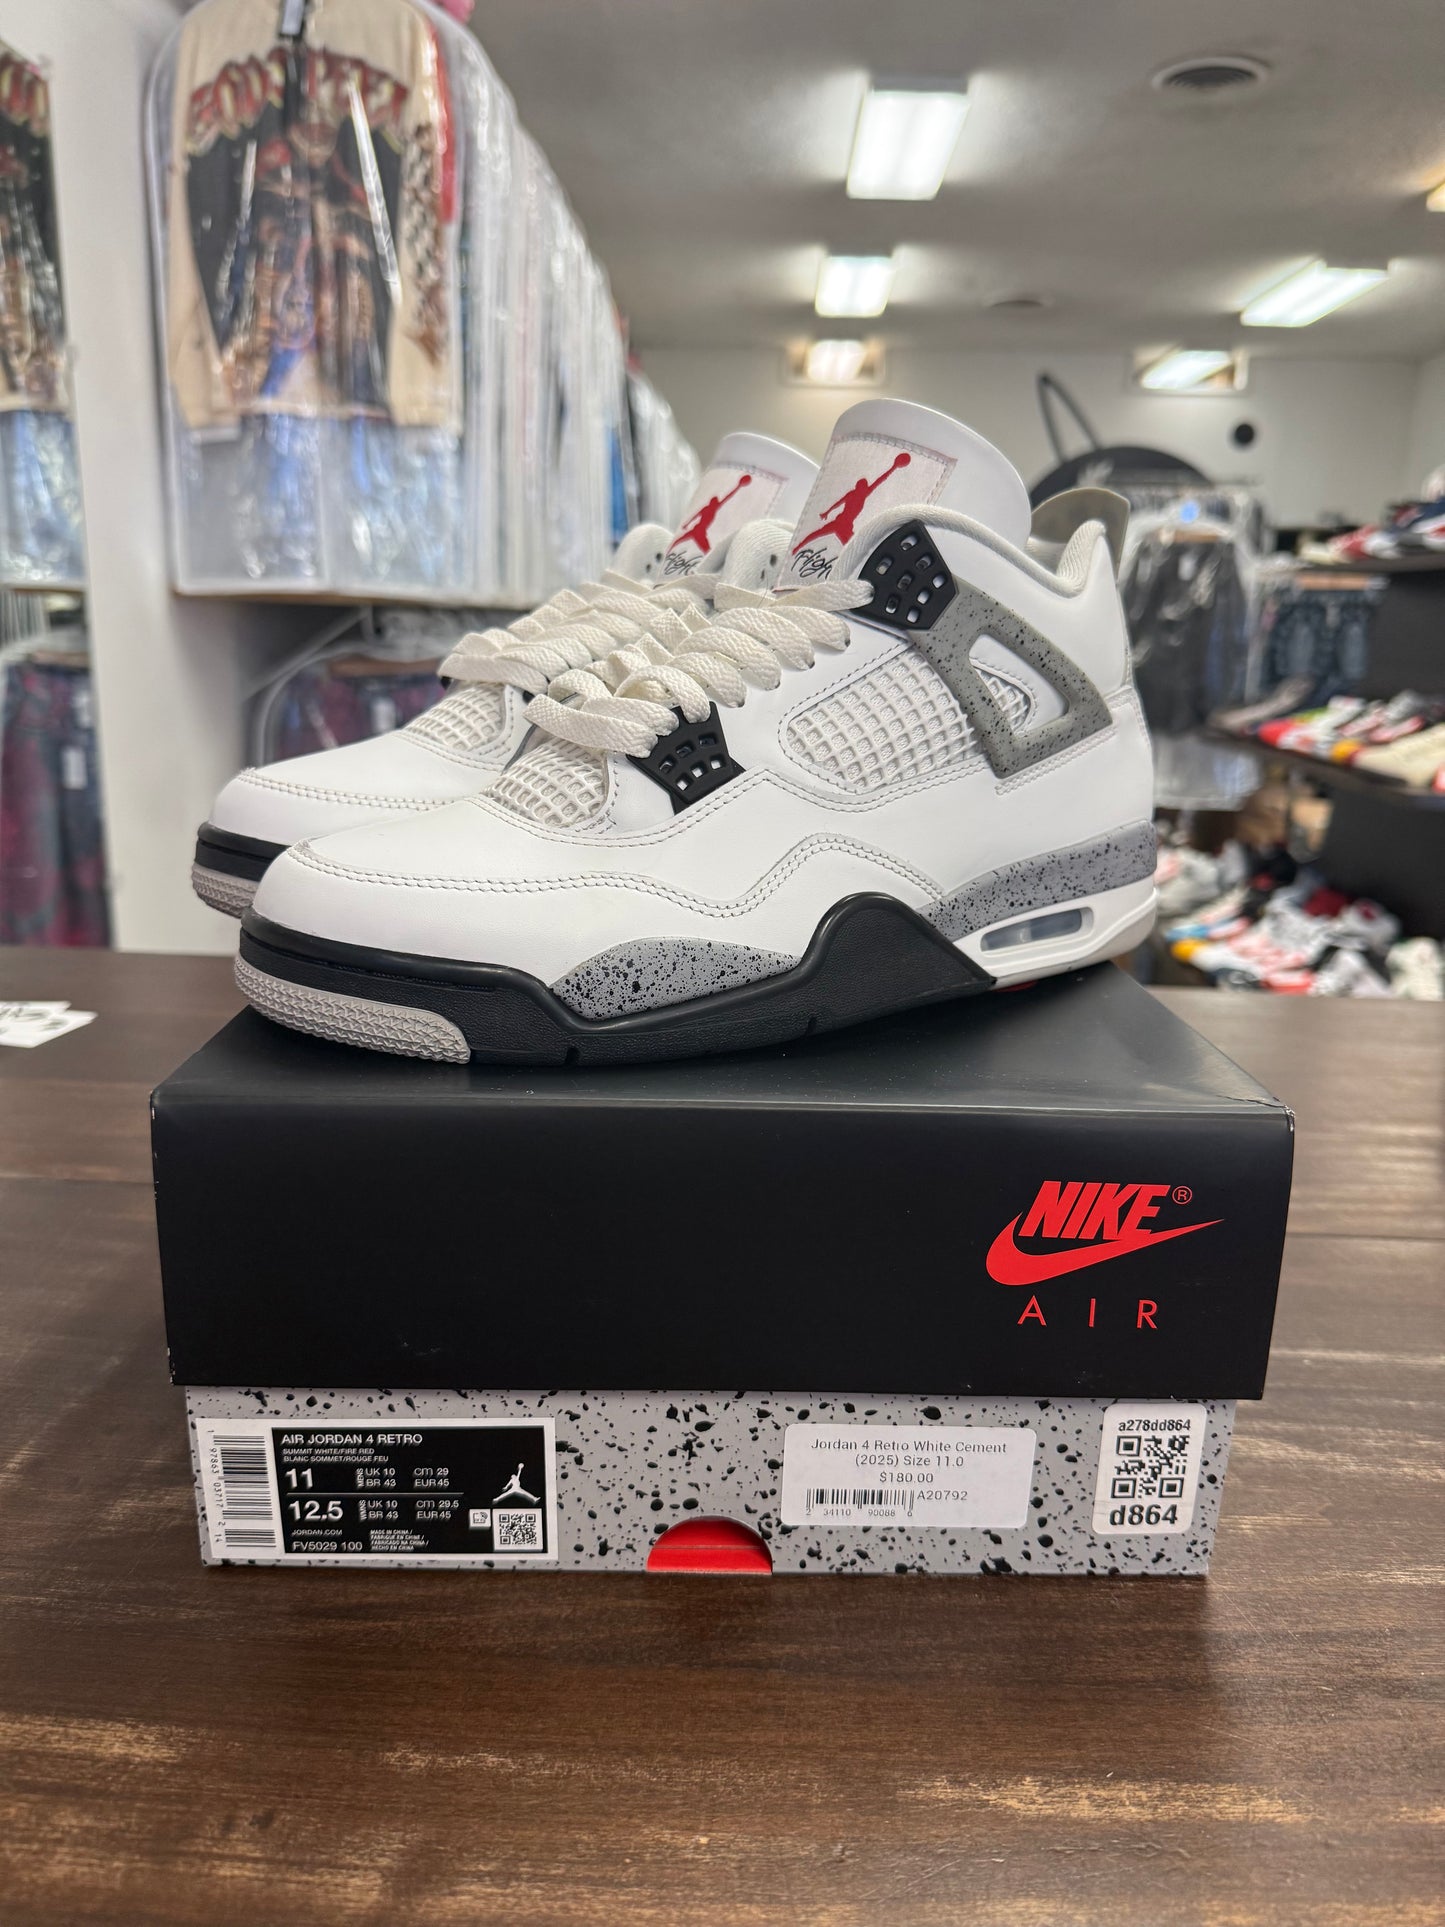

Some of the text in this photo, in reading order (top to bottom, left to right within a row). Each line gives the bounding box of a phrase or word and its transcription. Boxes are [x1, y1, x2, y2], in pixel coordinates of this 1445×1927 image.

[664, 550, 703, 576] Fligh
[791, 547, 838, 580] Fligh
[1018, 1180, 1171, 1241] NIKE
[1118, 1419, 1191, 1432] a278dd864
[281, 1433, 423, 1444] AIR JORDAN 4 RETRO
[811, 1438, 1007, 1453] Jordan 4 Retro White Cement
[209, 1447, 219, 1474] 97863
[855, 1454, 964, 1467] (2025) Size 11.0
[285, 1468, 313, 1488] 11
[365, 1468, 396, 1476] UK 10
[413, 1468, 449, 1476] cm 29
[879, 1471, 934, 1484] $180.00
[366, 1479, 397, 1487] BR 43
[414, 1479, 450, 1487] EUR 45
[213, 1482, 224, 1508] 03717
[917, 1490, 968, 1501] A20792
[288, 1500, 343, 1520] 12.5
[368, 1500, 398, 1508] UK 10
[416, 1500, 459, 1508] cm 29.5
[368, 1511, 399, 1519] BR 43
[416, 1511, 452, 1519] EUR 45
[805, 1508, 913, 1517] 2 34110 90088 6
[1109, 1504, 1178, 1526] d864
[292, 1541, 363, 1551] FV5029 100
